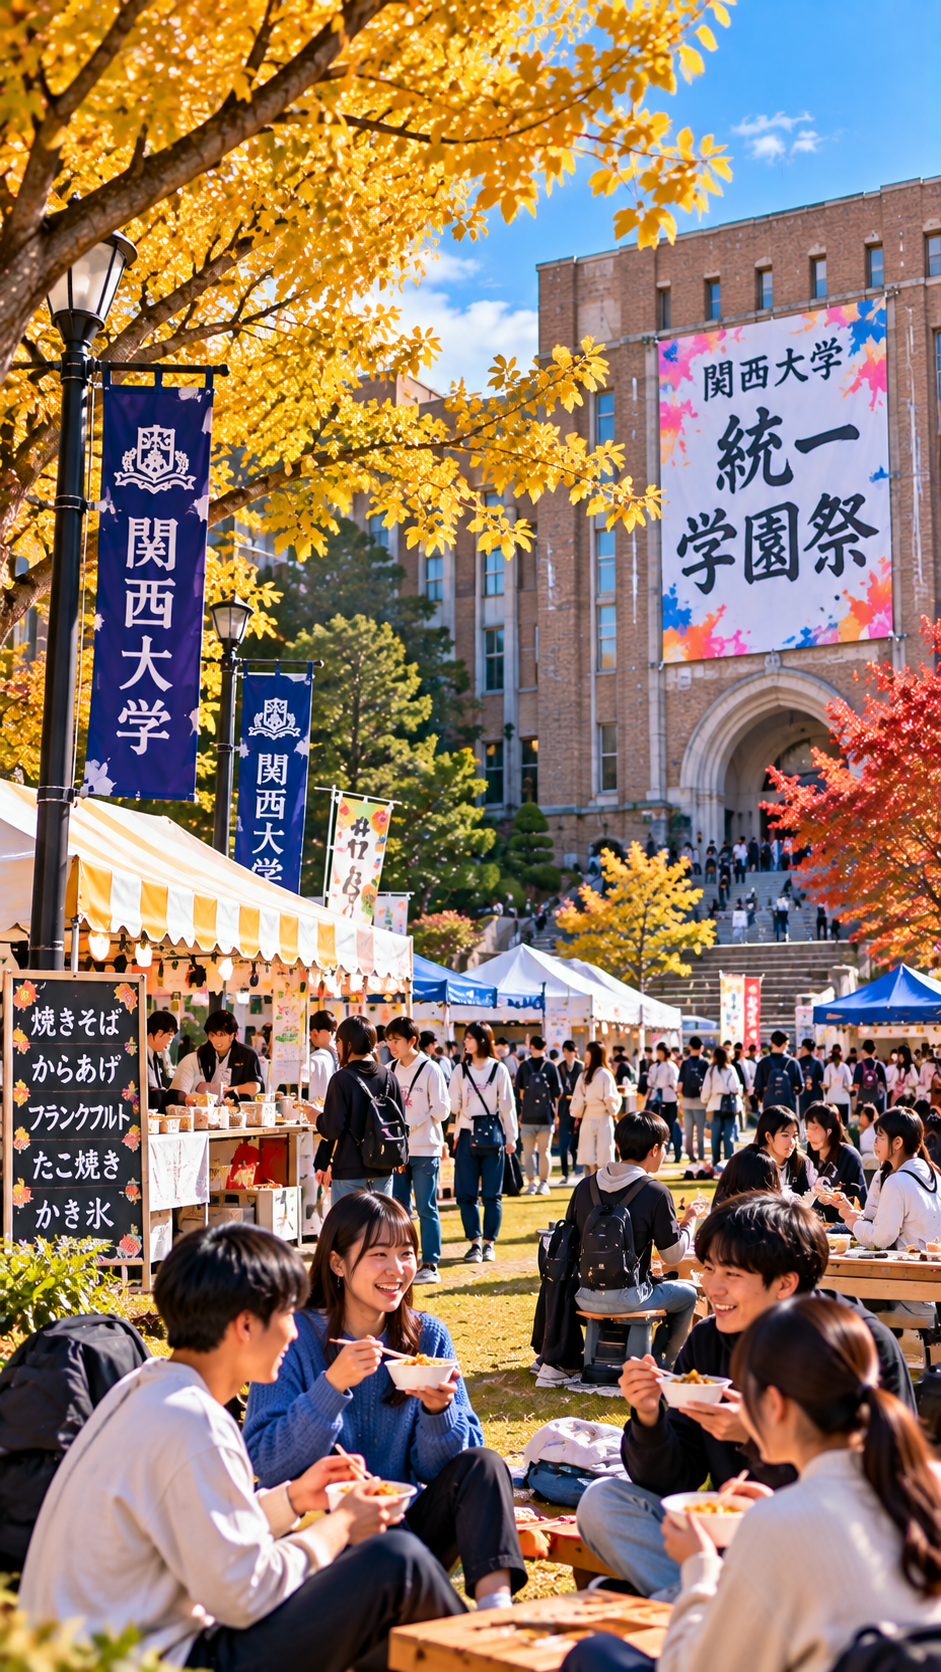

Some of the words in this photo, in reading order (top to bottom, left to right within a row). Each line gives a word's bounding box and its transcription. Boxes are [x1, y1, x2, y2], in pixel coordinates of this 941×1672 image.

[703, 337, 843, 402] 関西大学
[716, 406, 860, 494] 統一
[676, 492, 880, 595] 学園祭
[116, 516, 178, 756] 関西大学
[31, 1006, 123, 1037] 焼きそば
[31, 1054, 122, 1084] からあげ
[28, 1103, 130, 1131] フランクフルト
[33, 1149, 120, 1180] たこ焼き
[35, 1197, 115, 1229] かき氷
